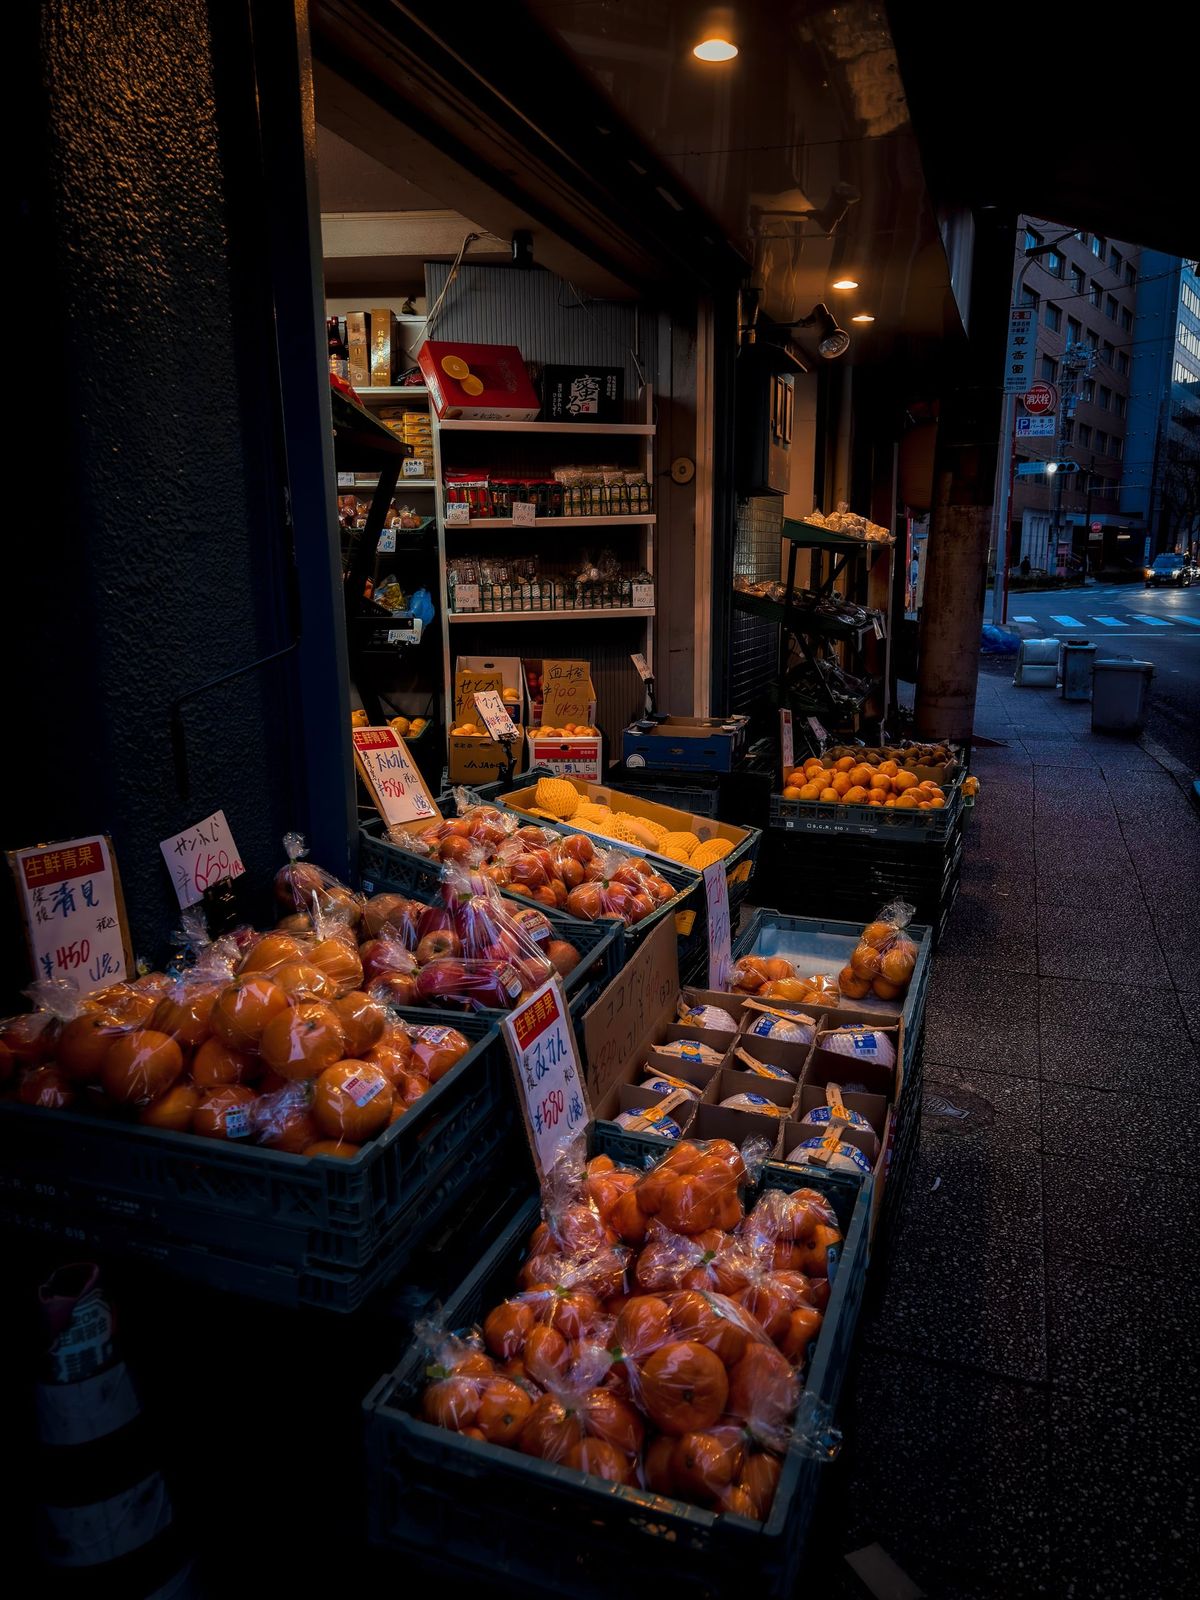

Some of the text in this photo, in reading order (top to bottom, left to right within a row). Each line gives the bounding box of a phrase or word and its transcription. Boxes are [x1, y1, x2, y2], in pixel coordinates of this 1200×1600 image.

[1026, 394, 1050, 405] 消火栓
[460, 679, 499, 695] せとか
[544, 683, 577, 703] ¥900
[353, 730, 391, 745] 生鮮青果
[174, 816, 219, 856] サンふじ
[25, 847, 95, 880] 生鮮青果
[49, 880, 99, 917] 清見
[514, 993, 555, 1040] 生鮮青果
[534, 1089, 564, 1135] ¥580
